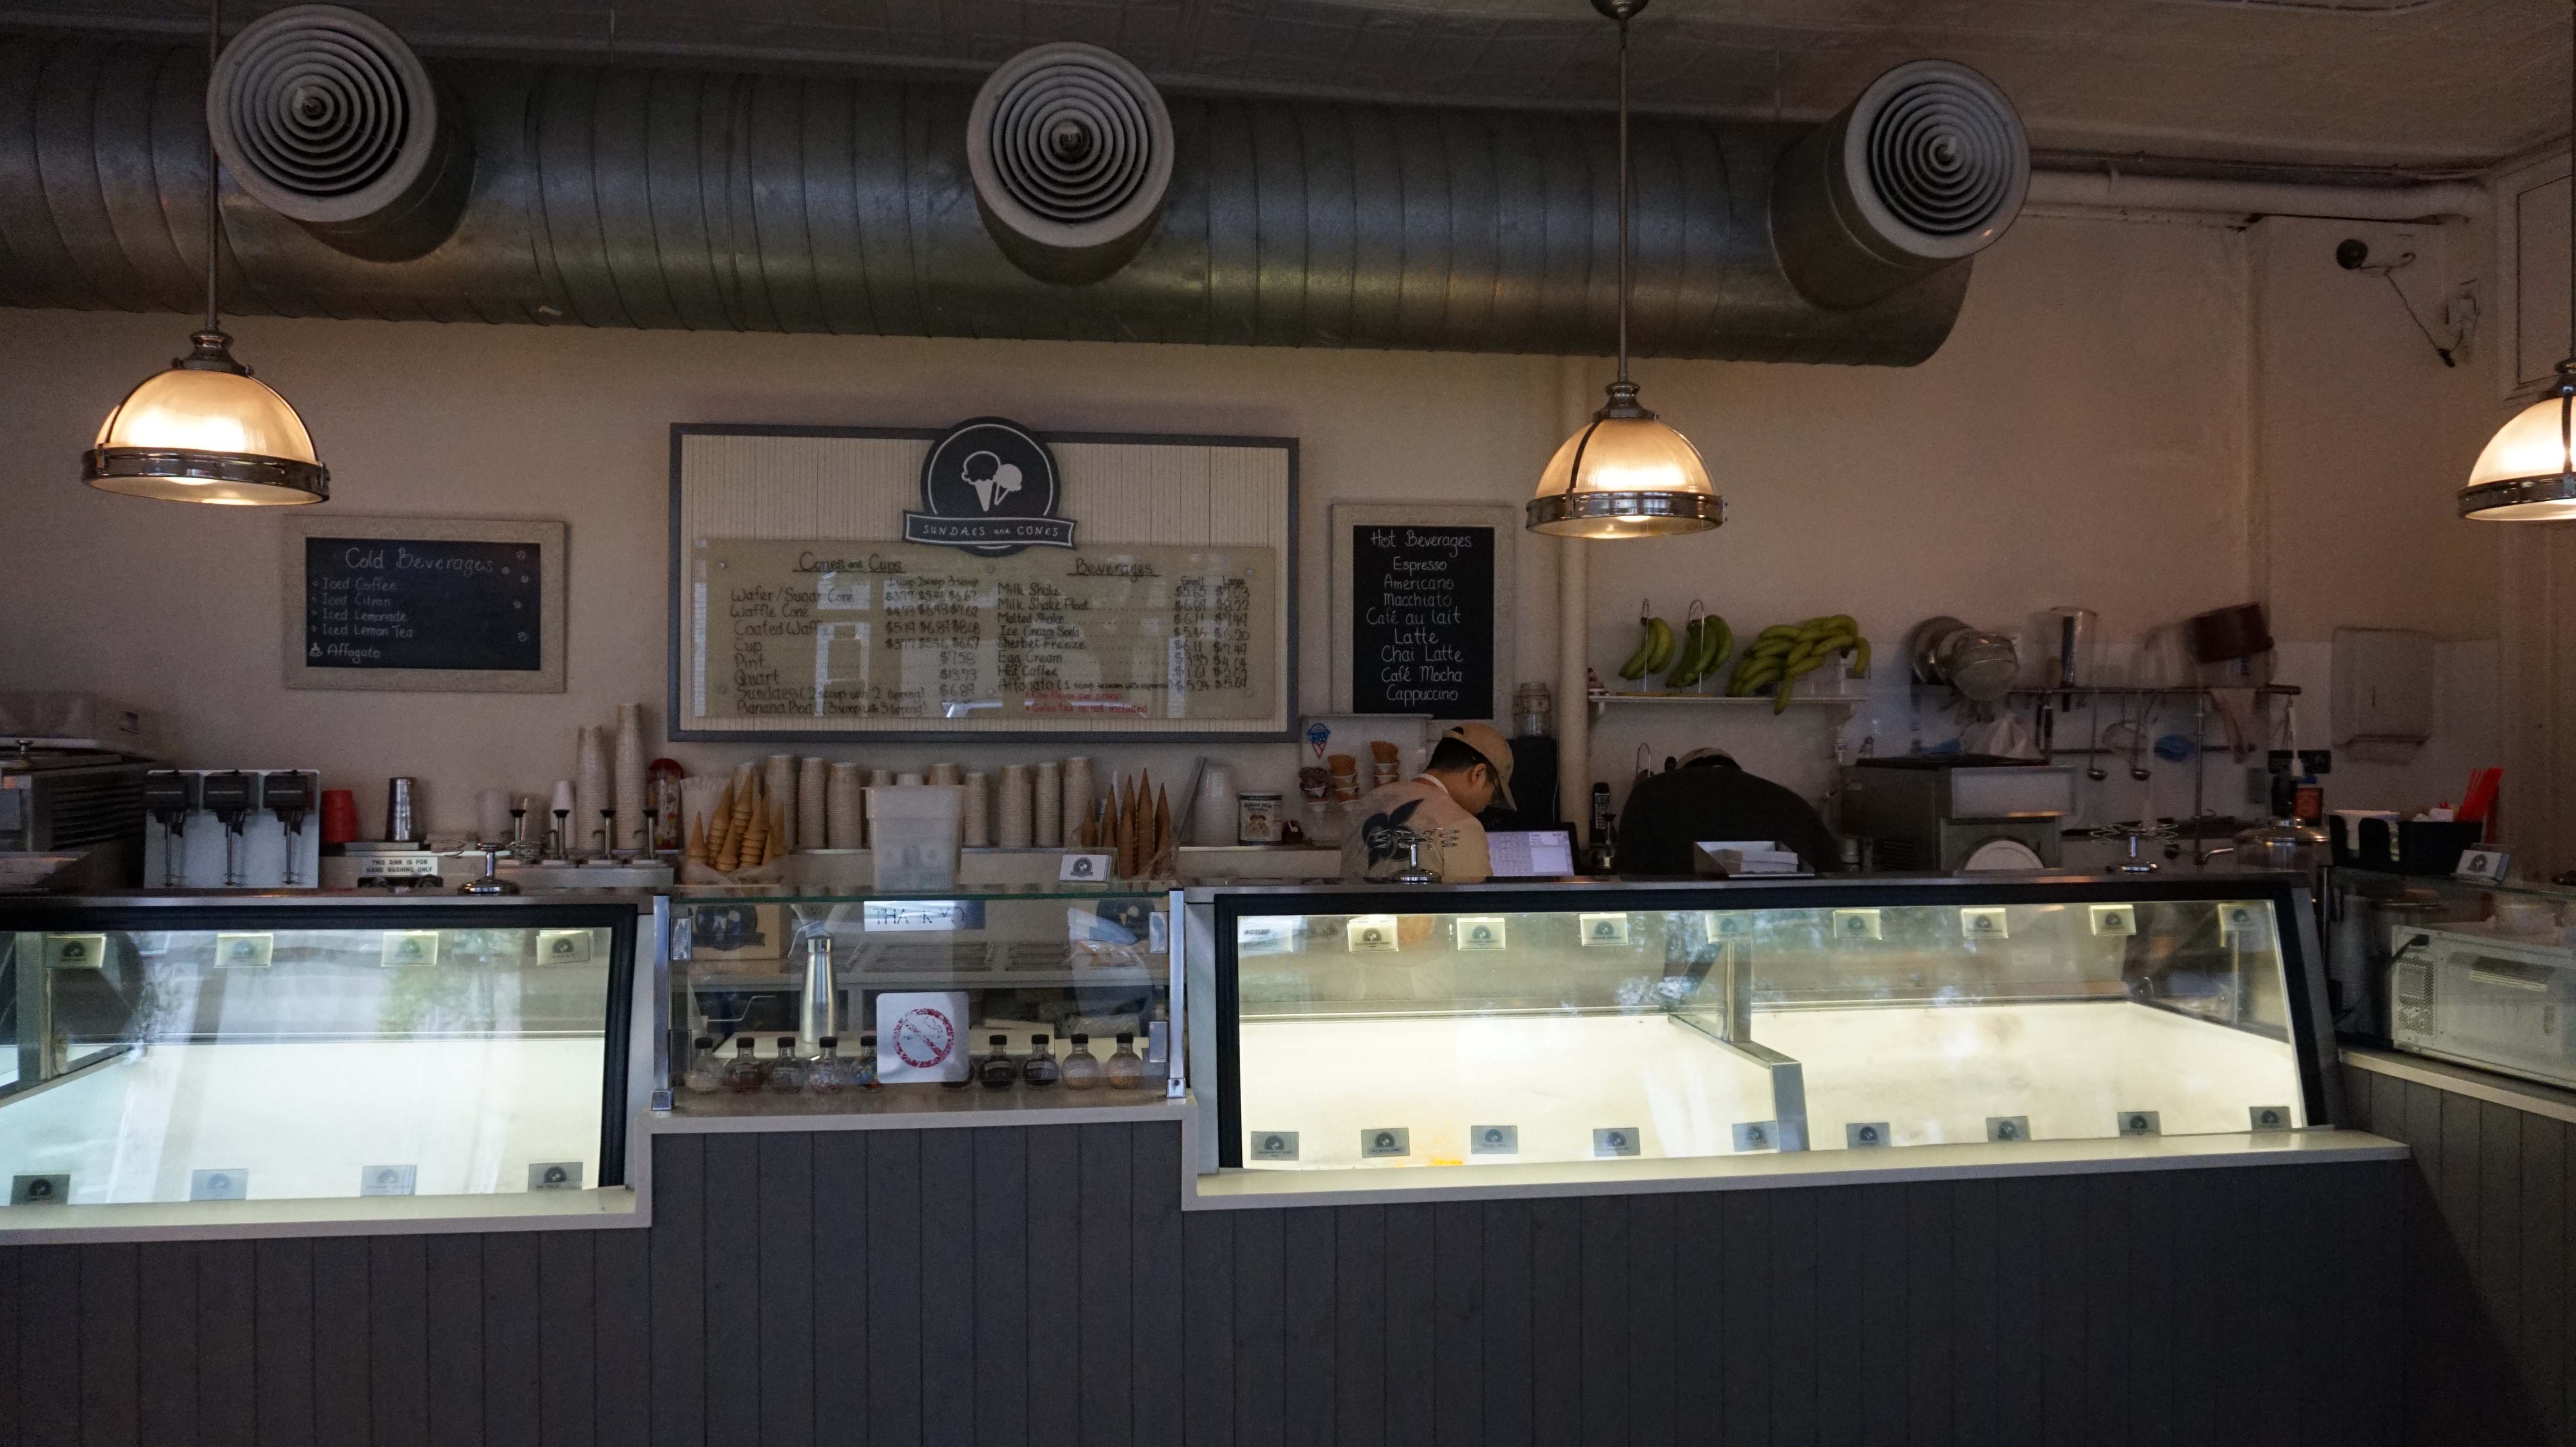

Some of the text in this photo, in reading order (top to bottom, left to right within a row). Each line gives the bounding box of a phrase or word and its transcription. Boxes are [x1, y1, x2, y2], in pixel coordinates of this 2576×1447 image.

[1017, 526, 1058, 536] CONES
[1372, 529, 1472, 557] Hot Beverages
[345, 548, 493, 577] Cold Beverages
[799, 552, 844, 571] Cones
[869, 553, 902, 573] Cups
[1076, 557, 1153, 582] Beverages
[1393, 556, 1447, 576] Espresso
[322, 577, 397, 591] Iced Coffee
[997, 582, 1024, 596] Milk
[1029, 582, 1062, 596] Shake
[1384, 574, 1454, 590] Americano
[322, 593, 391, 607] Iced Citron
[997, 596, 1024, 610] Milk
[1029, 597, 1062, 611] Shake
[1384, 592, 1452, 606] Macchiato
[322, 609, 407, 622] Iced Lemonade
[730, 603, 777, 617] Waffle
[782, 604, 809, 617] Cone
[1366, 606, 1462, 625] Café au lait
[998, 613, 1031, 624] Malted
[1036, 613, 1064, 623] Shake
[322, 623, 413, 638] Iced Lemon Tea
[734, 619, 783, 636] Coated
[1000, 625, 1018, 635] Ice
[1044, 638, 1087, 650] Freeze
[1394, 628, 1439, 644] Latte
[734, 638, 763, 653] Cup
[734, 653, 766, 670] Pint
[998, 650, 1021, 668] Egg
[1026, 650, 1062, 663] Cream
[1381, 646, 1463, 662] Chai Latte
[735, 669, 780, 688] Quart
[1381, 666, 1463, 682] Café Mocha
[1386, 684, 1458, 707] Cappuccino
